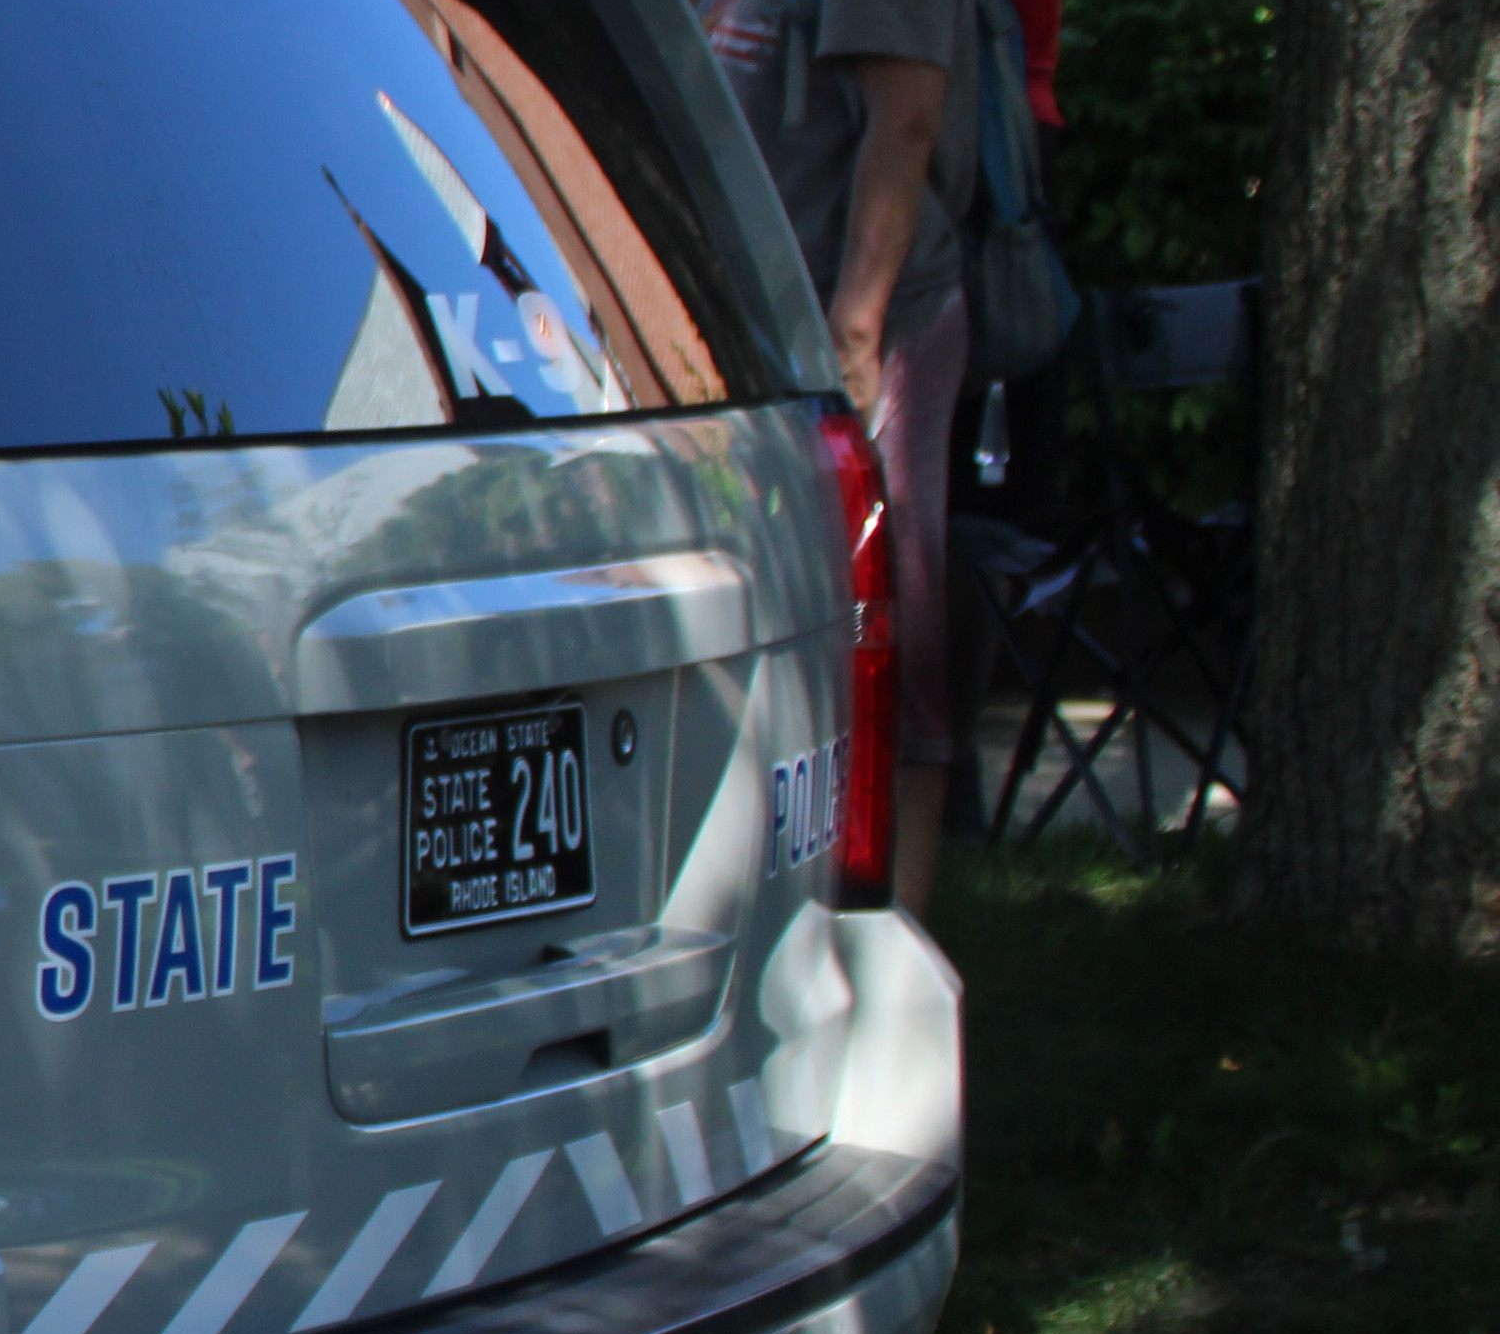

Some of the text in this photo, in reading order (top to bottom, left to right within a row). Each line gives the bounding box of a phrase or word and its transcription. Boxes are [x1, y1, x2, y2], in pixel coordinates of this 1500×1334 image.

[426, 291, 581, 398] K-9
[450, 720, 550, 760] OCEAN STATE
[414, 818, 498, 872] POLICE
[422, 748, 583, 862] STATE 240
[450, 865, 557, 912] RHODE ISLAND
[36, 852, 298, 1023] STATE
